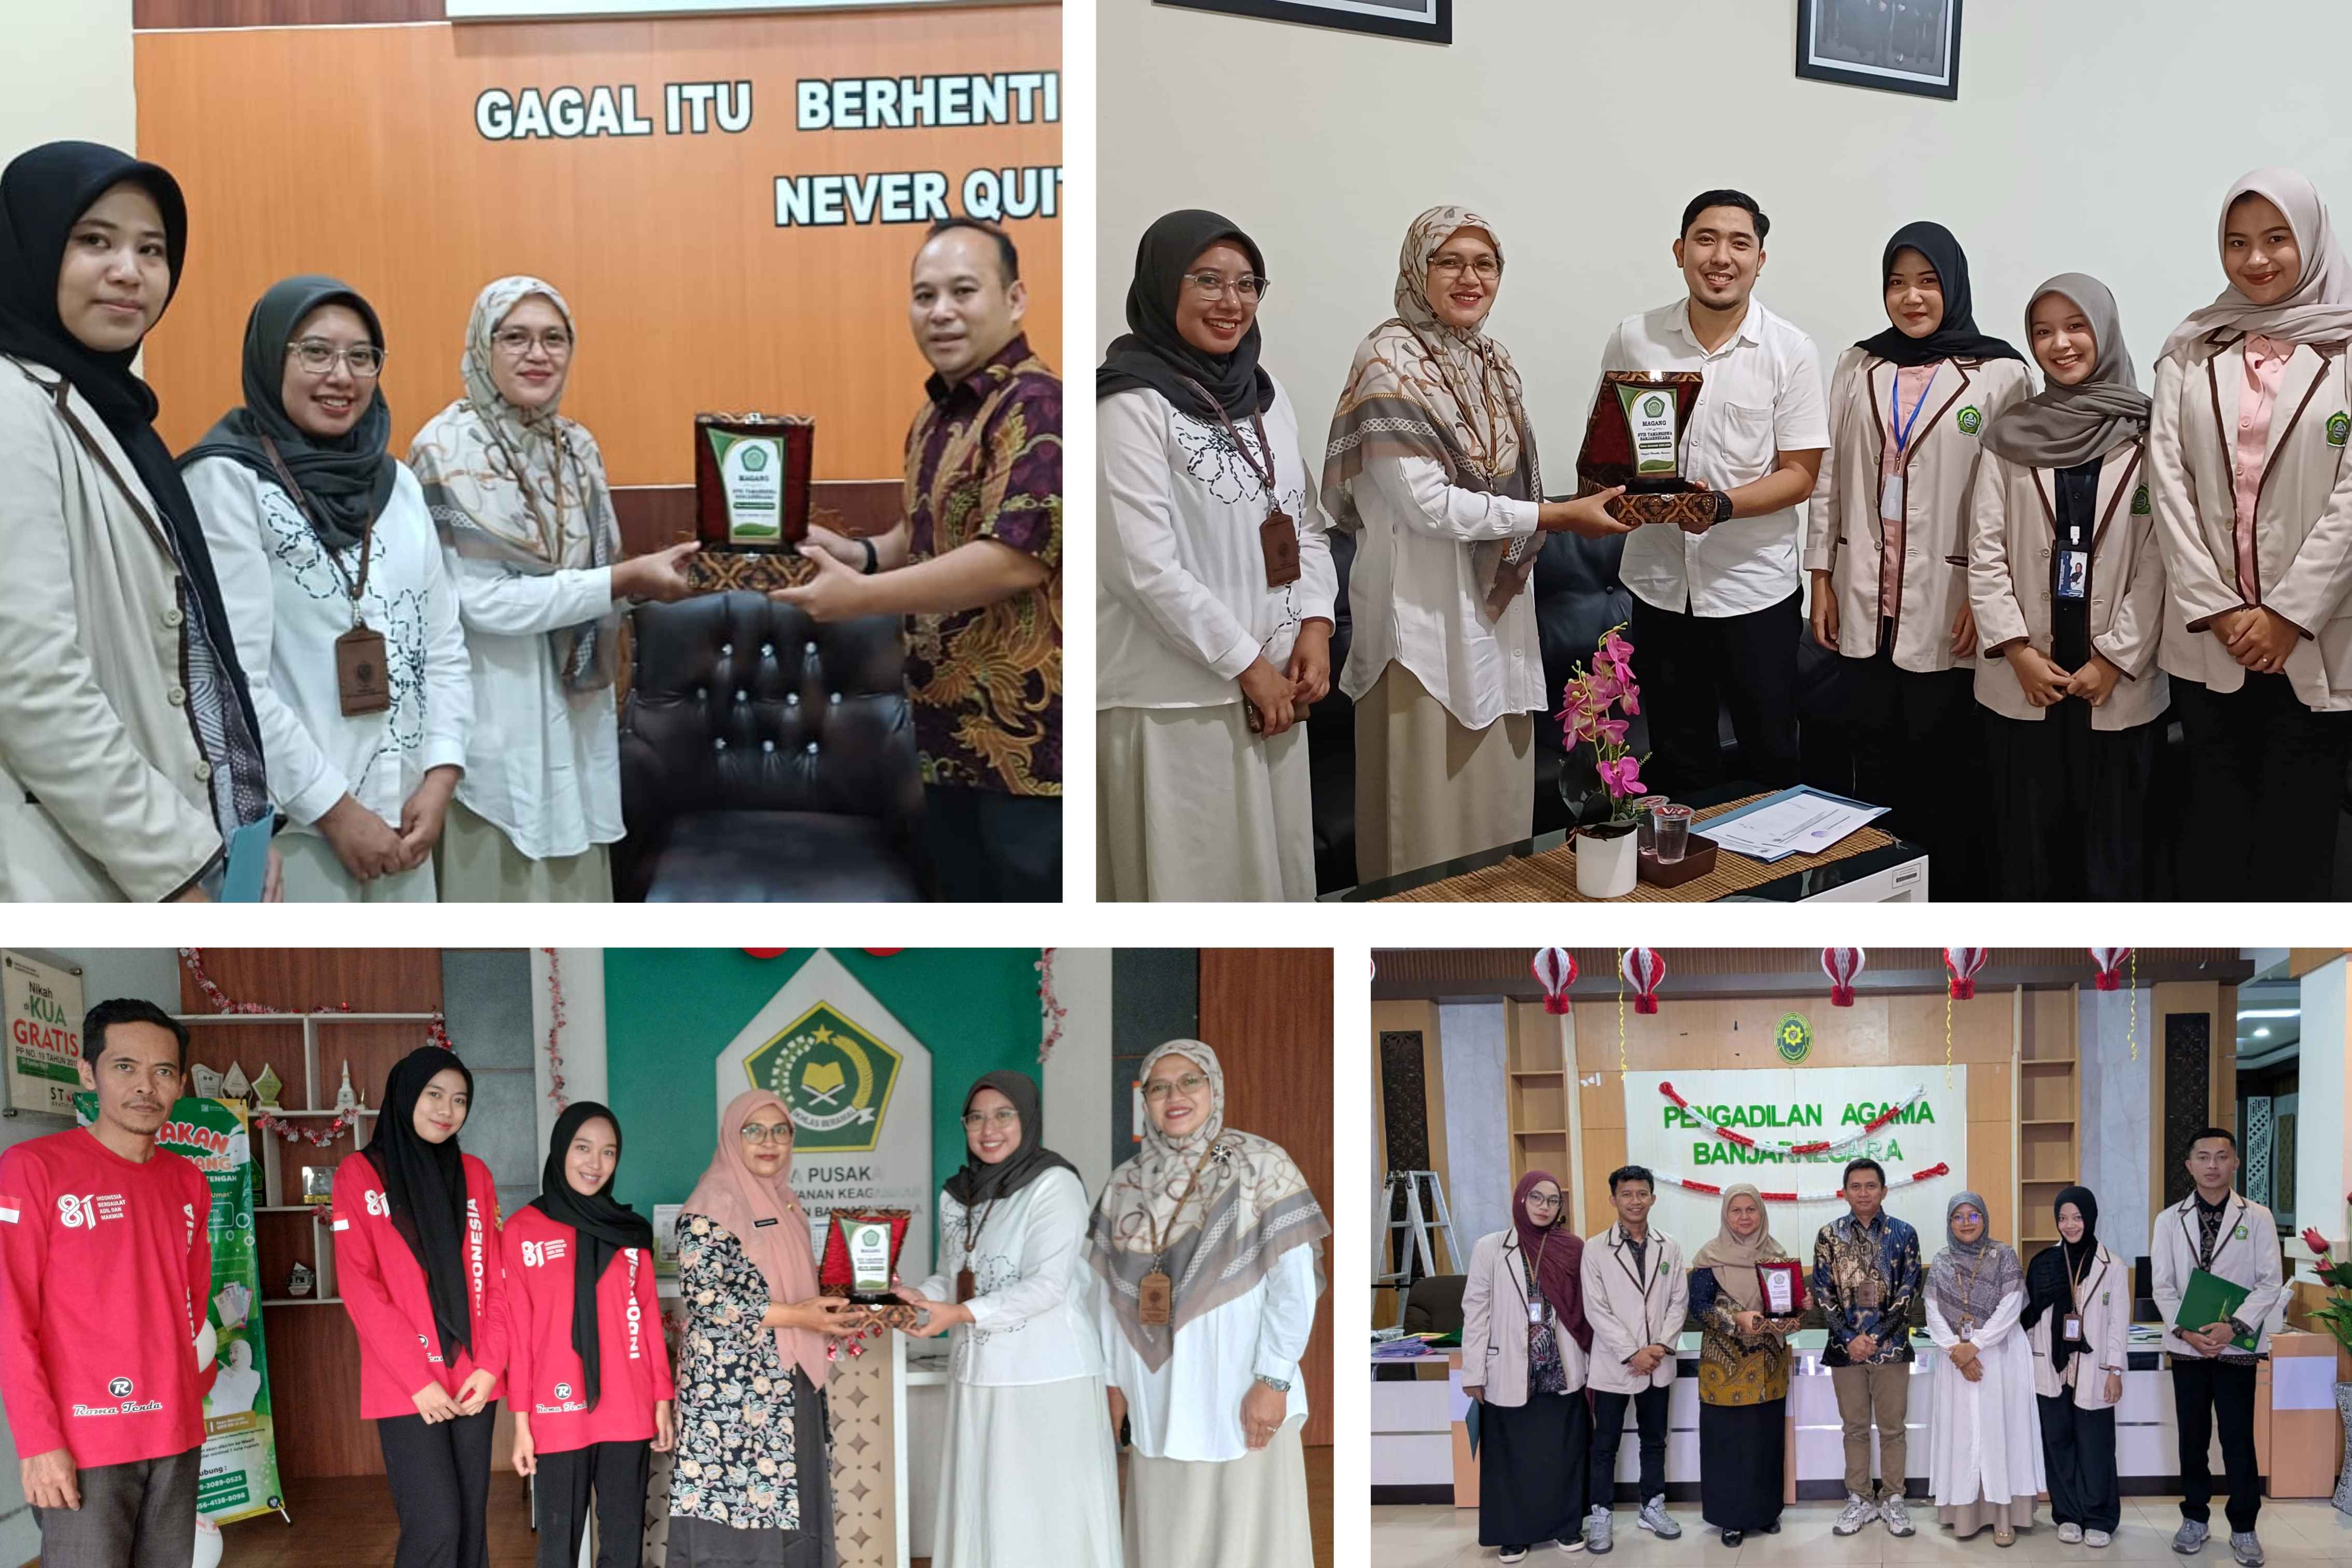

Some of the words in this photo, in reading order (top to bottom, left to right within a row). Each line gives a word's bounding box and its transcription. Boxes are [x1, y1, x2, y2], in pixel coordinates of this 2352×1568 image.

[475, 85, 652, 140] GAGAL
[665, 80, 752, 134] ITU
[796, 71, 1060, 130] BERHENTI
[774, 170, 949, 227] NEVER
[29, 981, 53, 999] Nikah
[30, 995, 67, 1027] KUA
[13, 1019, 79, 1057] GRATIS
[16, 1046, 24, 1054] PP
[46, 1053, 66, 1064] TAHUN
[1663, 1104, 1822, 1128] PENGADILAN
[1841, 1101, 1936, 1126] AGAMA
[155, 1121, 229, 1155] AKAN
[183, 1155, 232, 1172] ANG
[809, 1166, 884, 1183] PUSAK
[58, 1194, 96, 1230] 81
[98, 1199, 126, 1208] BERDAULAT
[365, 1189, 390, 1218] 81
[521, 1241, 545, 1268] 81
[73, 1404, 119, 1417] Roma
[121, 1400, 162, 1414] Tenda
[199, 1475, 242, 1490] 8-3089-0525
